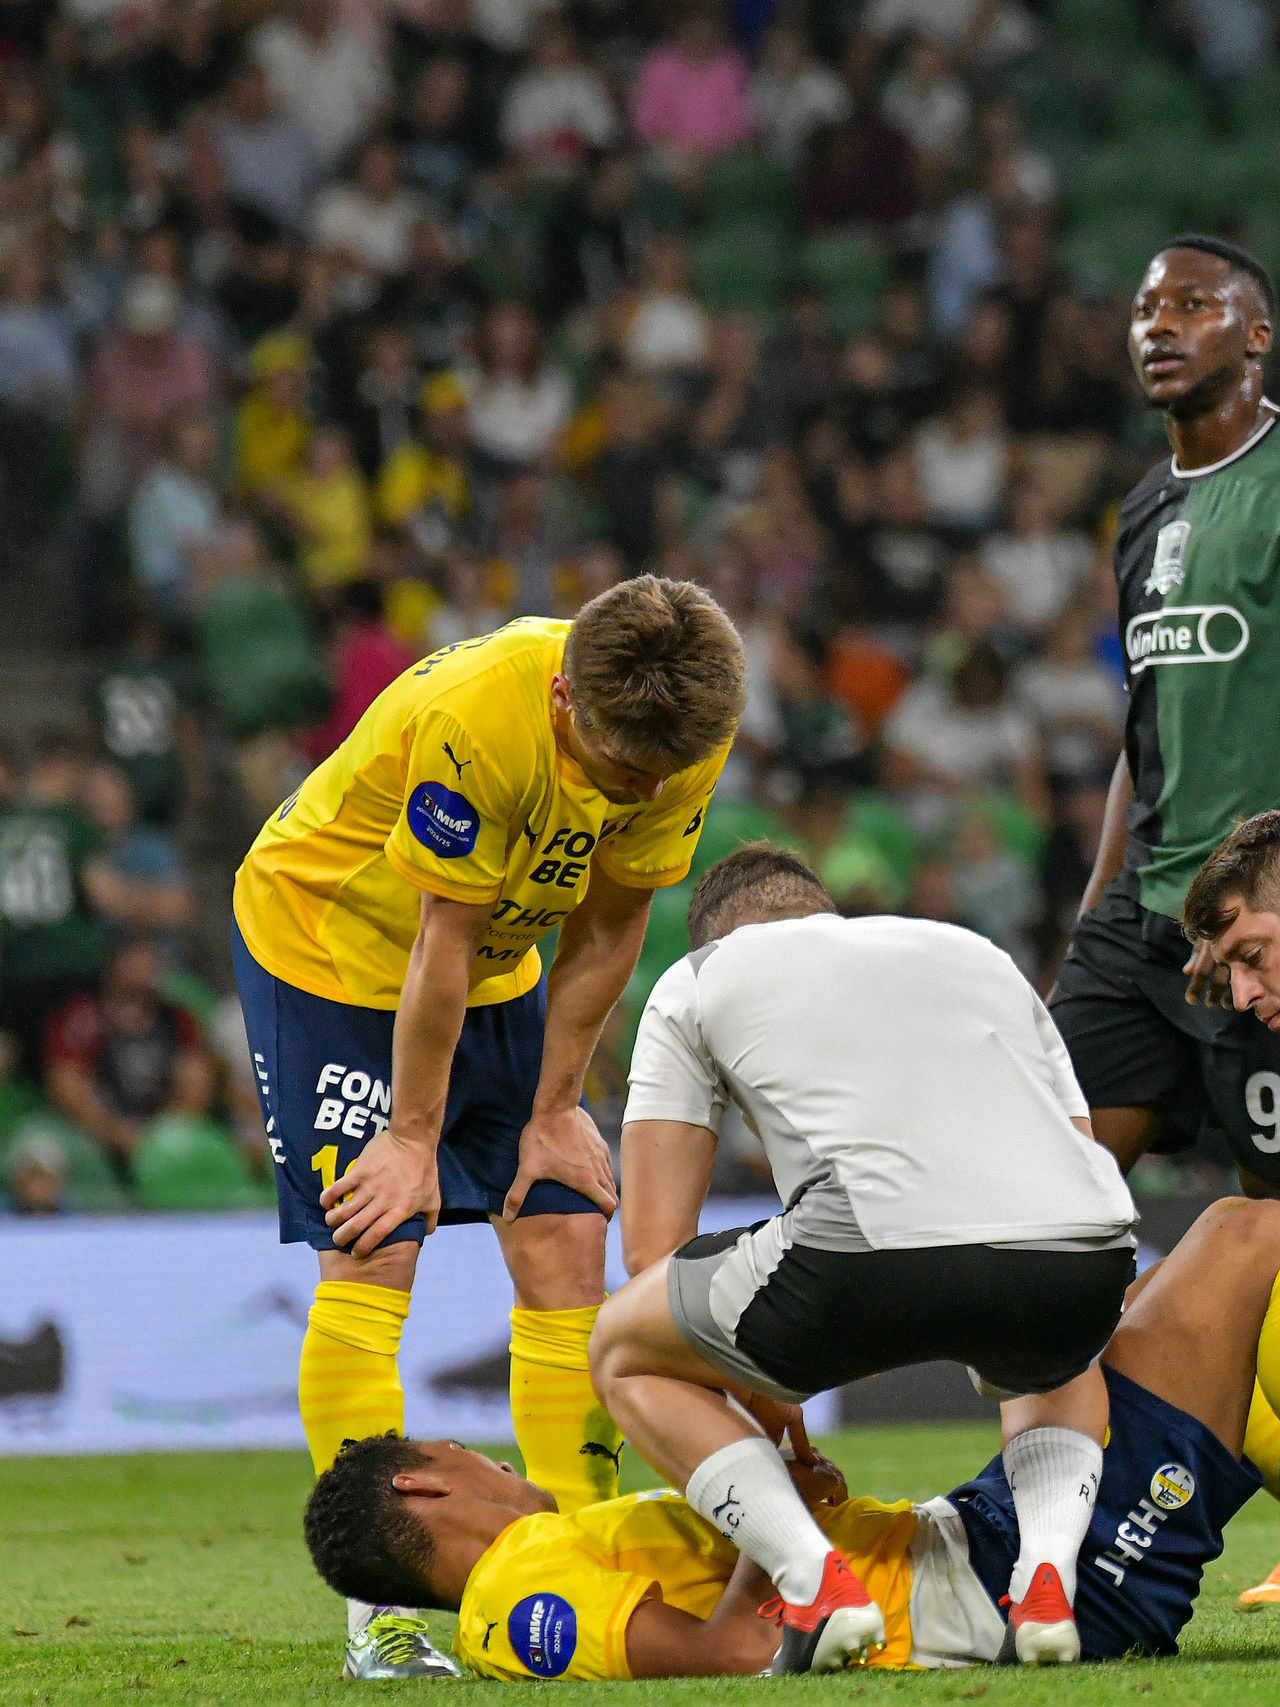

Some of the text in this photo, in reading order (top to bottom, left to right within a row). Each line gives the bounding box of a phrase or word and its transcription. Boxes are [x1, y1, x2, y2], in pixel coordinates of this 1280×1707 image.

[541, 828, 596, 858] FO
[529, 860, 587, 889] BE
[316, 1063, 392, 1114] FON
[313, 1097, 391, 1139] BET
